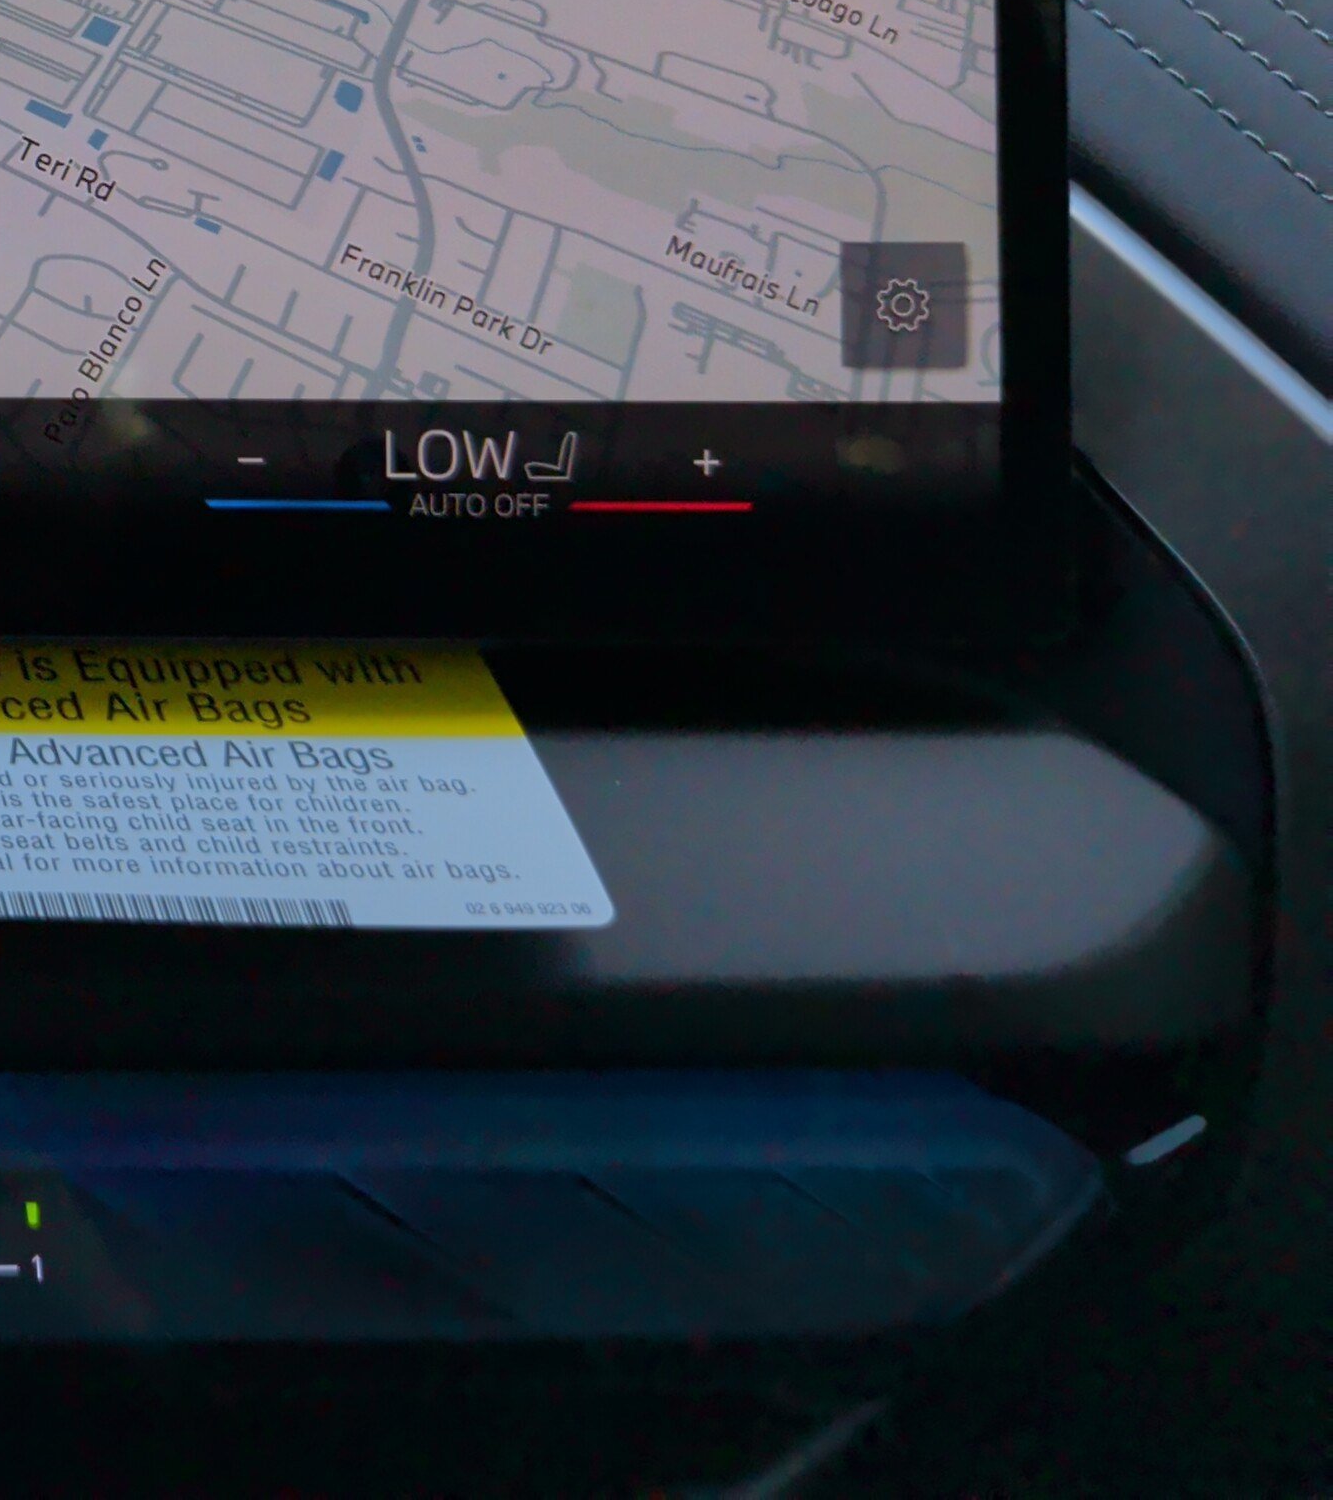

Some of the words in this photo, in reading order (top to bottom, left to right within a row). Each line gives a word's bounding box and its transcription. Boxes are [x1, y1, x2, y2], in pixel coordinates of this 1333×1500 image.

[867, 11, 901, 42] Ln
[17, 135, 73, 183] Teri
[75, 166, 118, 203] Rd
[666, 235, 783, 303] Maufrais
[785, 281, 822, 317] Ln
[79, 294, 143, 382] Blanco
[131, 256, 168, 297] Ln
[339, 244, 448, 311] Franklin
[453, 292, 515, 342] Park
[516, 323, 554, 359] Dr
[384, 429, 520, 481] LOW
[409, 494, 488, 519] AUTO
[494, 494, 552, 518] OFF
[19, 650, 60, 683] is
[78, 650, 304, 690] Equipped
[315, 654, 424, 687] with
[106, 691, 169, 723] Air
[186, 691, 312, 731] Bags
[10, 737, 208, 769] Advanced
[223, 740, 276, 770] Air
[288, 741, 395, 775] Bags
[0, 790, 23, 808] is
[32, 791, 75, 809] the
[83, 792, 163, 811] safest
[172, 793, 241, 816] place
[248, 794, 285, 813] for
[294, 794, 412, 814] children.
[23, 774, 50, 789] or
[59, 772, 176, 794] seriously
[186, 773, 276, 795] injured
[285, 774, 317, 796] by
[325, 775, 369, 794] the
[377, 775, 411, 794] air
[419, 776, 477, 798] bag.
[131, 814, 192, 834] child
[201, 818, 257, 835] seat
[266, 816, 290, 835] in
[297, 817, 341, 836] the
[349, 817, 424, 837] front.
[1, 834, 54, 851] seat
[64, 833, 129, 853] belts
[140, 835, 187, 854] and
[196, 836, 261, 856] child
[271, 837, 409, 858] restraints.
[23, 854, 62, 873] for
[73, 858, 141, 875] more
[150, 855, 308, 879] information
[317, 859, 396, 880] about
[403, 860, 435, 879] air
[444, 860, 522, 884] bags.
